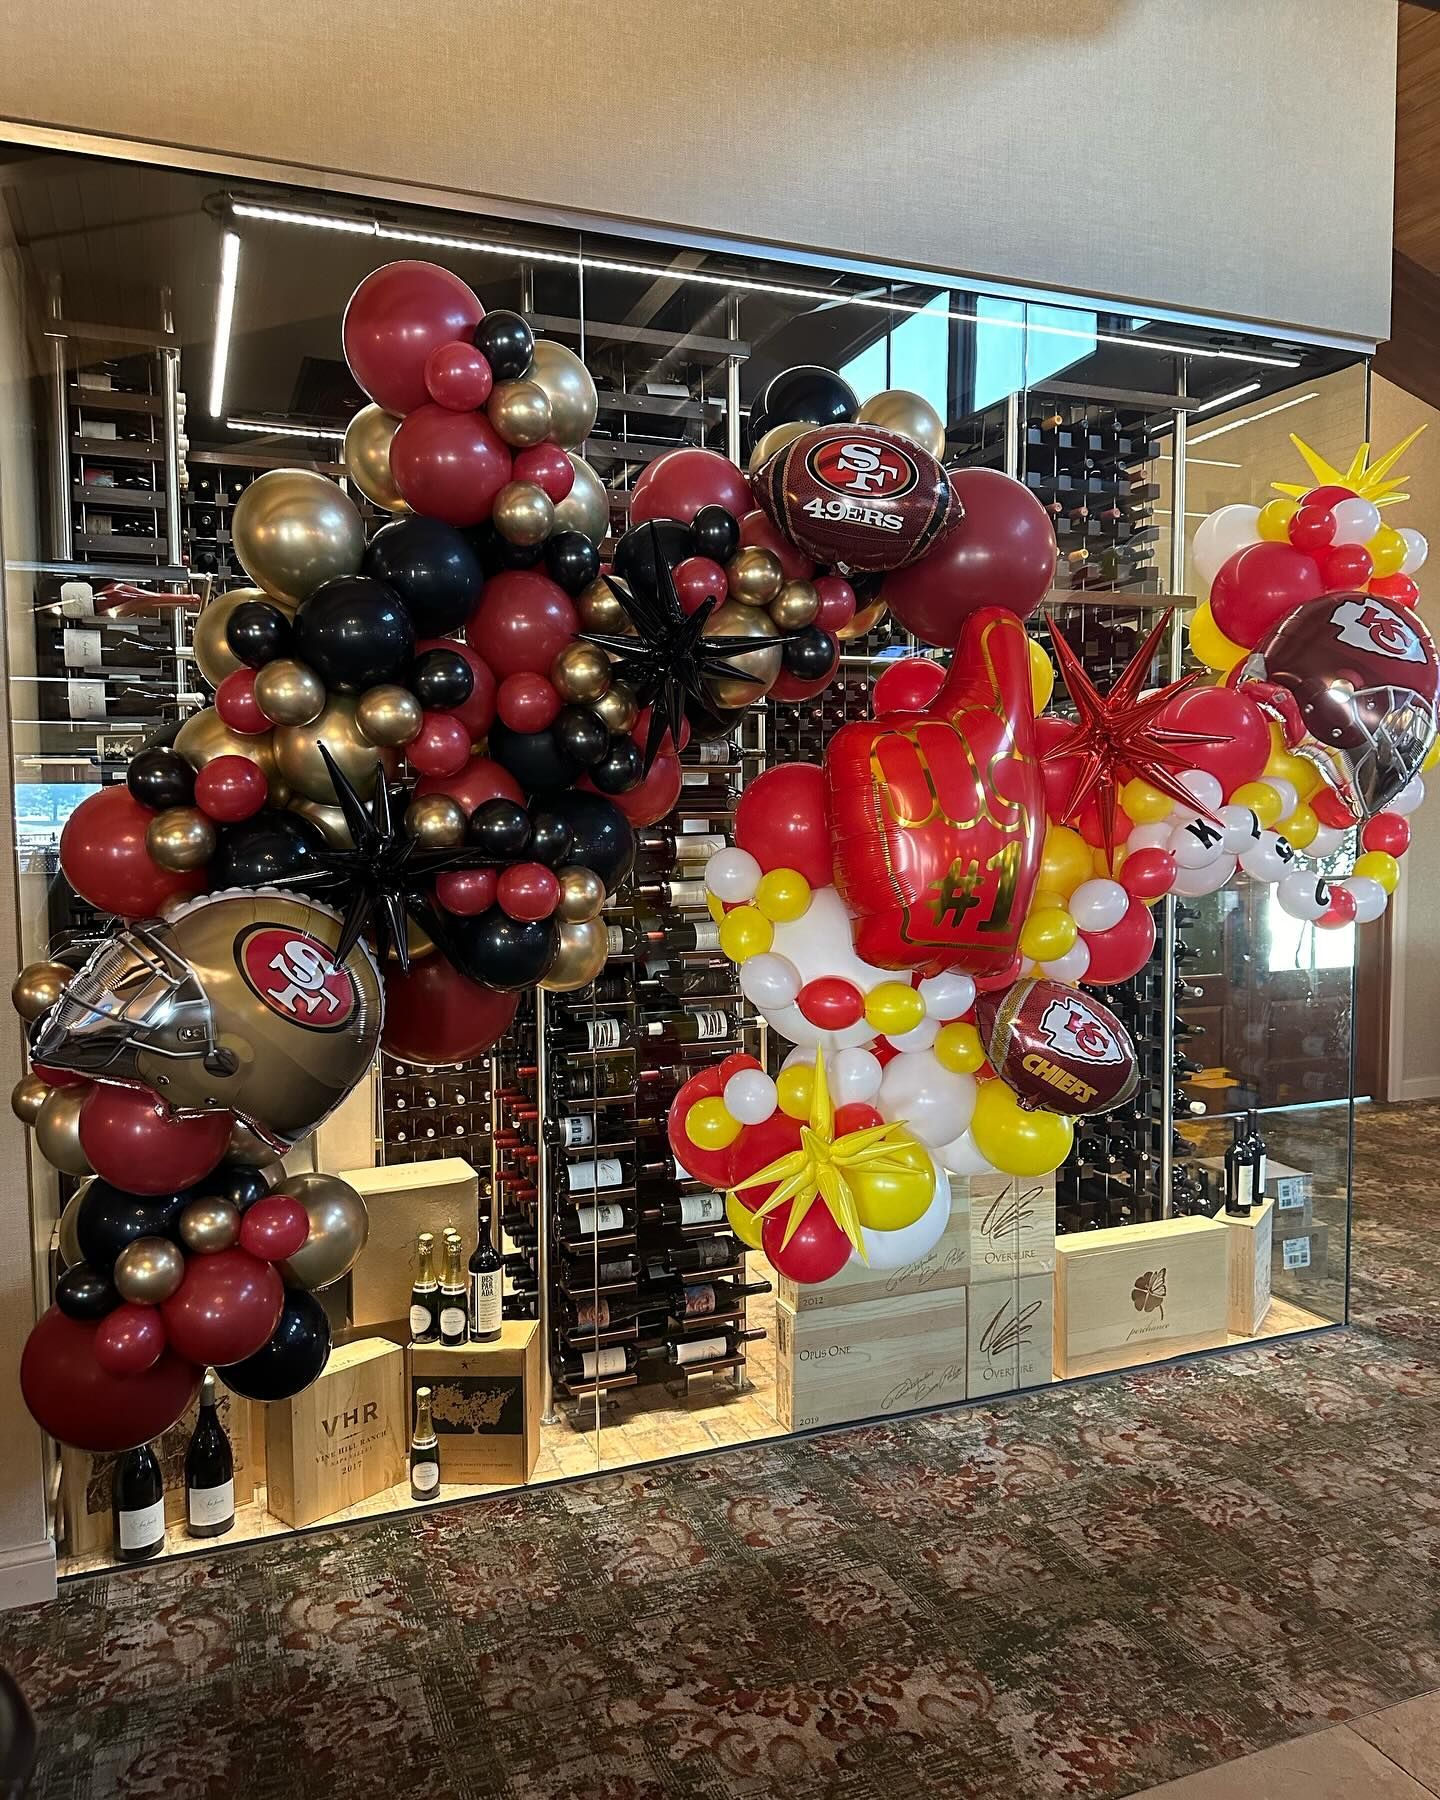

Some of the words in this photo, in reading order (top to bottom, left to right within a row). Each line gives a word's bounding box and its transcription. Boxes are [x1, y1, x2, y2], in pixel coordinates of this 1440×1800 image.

[802, 497, 905, 531] 49ERS
[926, 840, 1023, 933] #1
[1022, 1053, 1099, 1104] CHIEFS
[803, 1297, 824, 1306] 2012
[799, 1350, 826, 1361] OPUS
[829, 1345, 850, 1356] ONE
[321, 1401, 379, 1438] VHR
[799, 1416, 819, 1426] 2019
[315, 1451, 336, 1463] VINE
[338, 1442, 356, 1455] HILL
[342, 1460, 362, 1475] 2017
